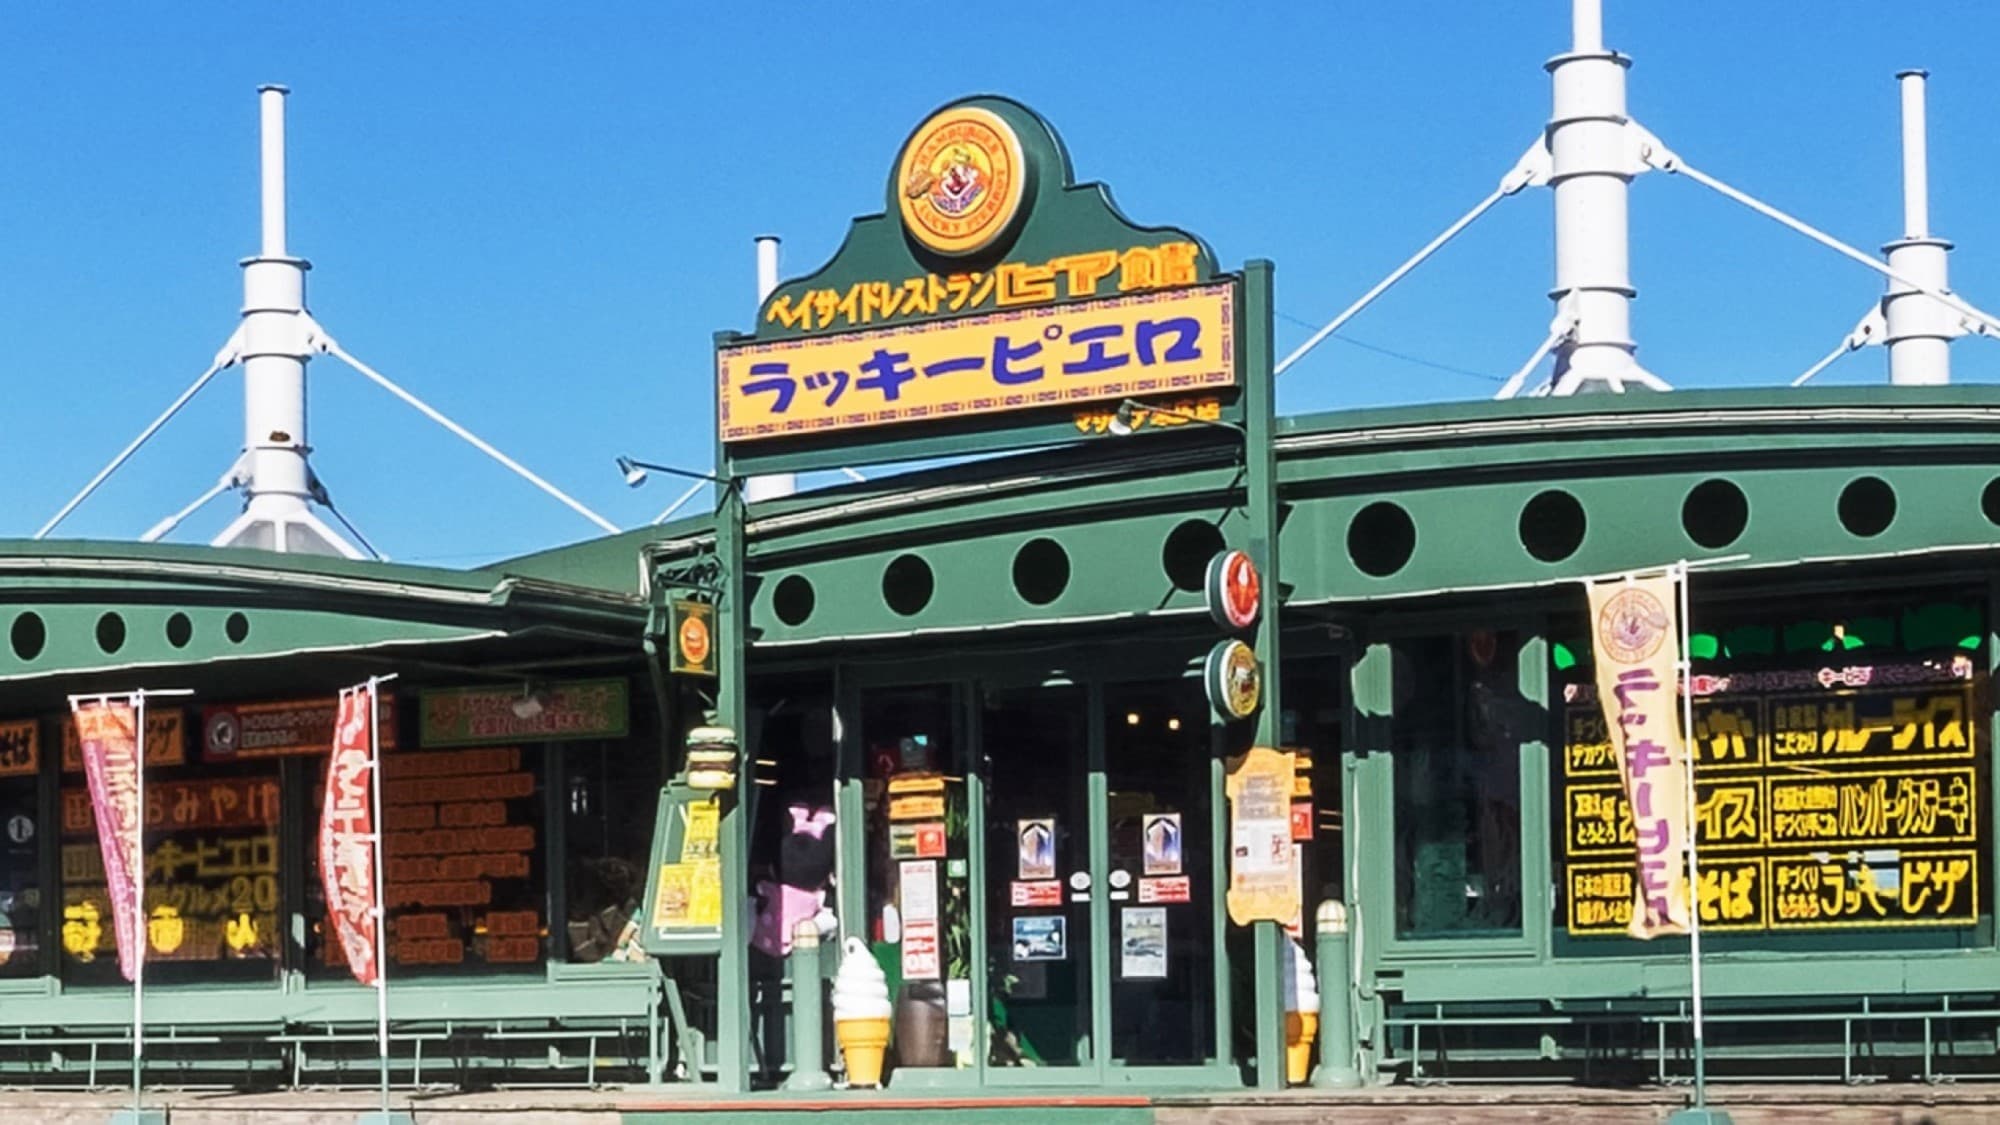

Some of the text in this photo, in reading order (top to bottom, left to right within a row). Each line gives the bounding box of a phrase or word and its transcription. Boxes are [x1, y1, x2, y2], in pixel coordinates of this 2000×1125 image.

[919, 202, 961, 233] LUCKY
[740, 316, 1202, 412] ラッキーピエロ
[1575, 792, 1616, 820] Big
[1576, 821, 1617, 846] とろとろ
